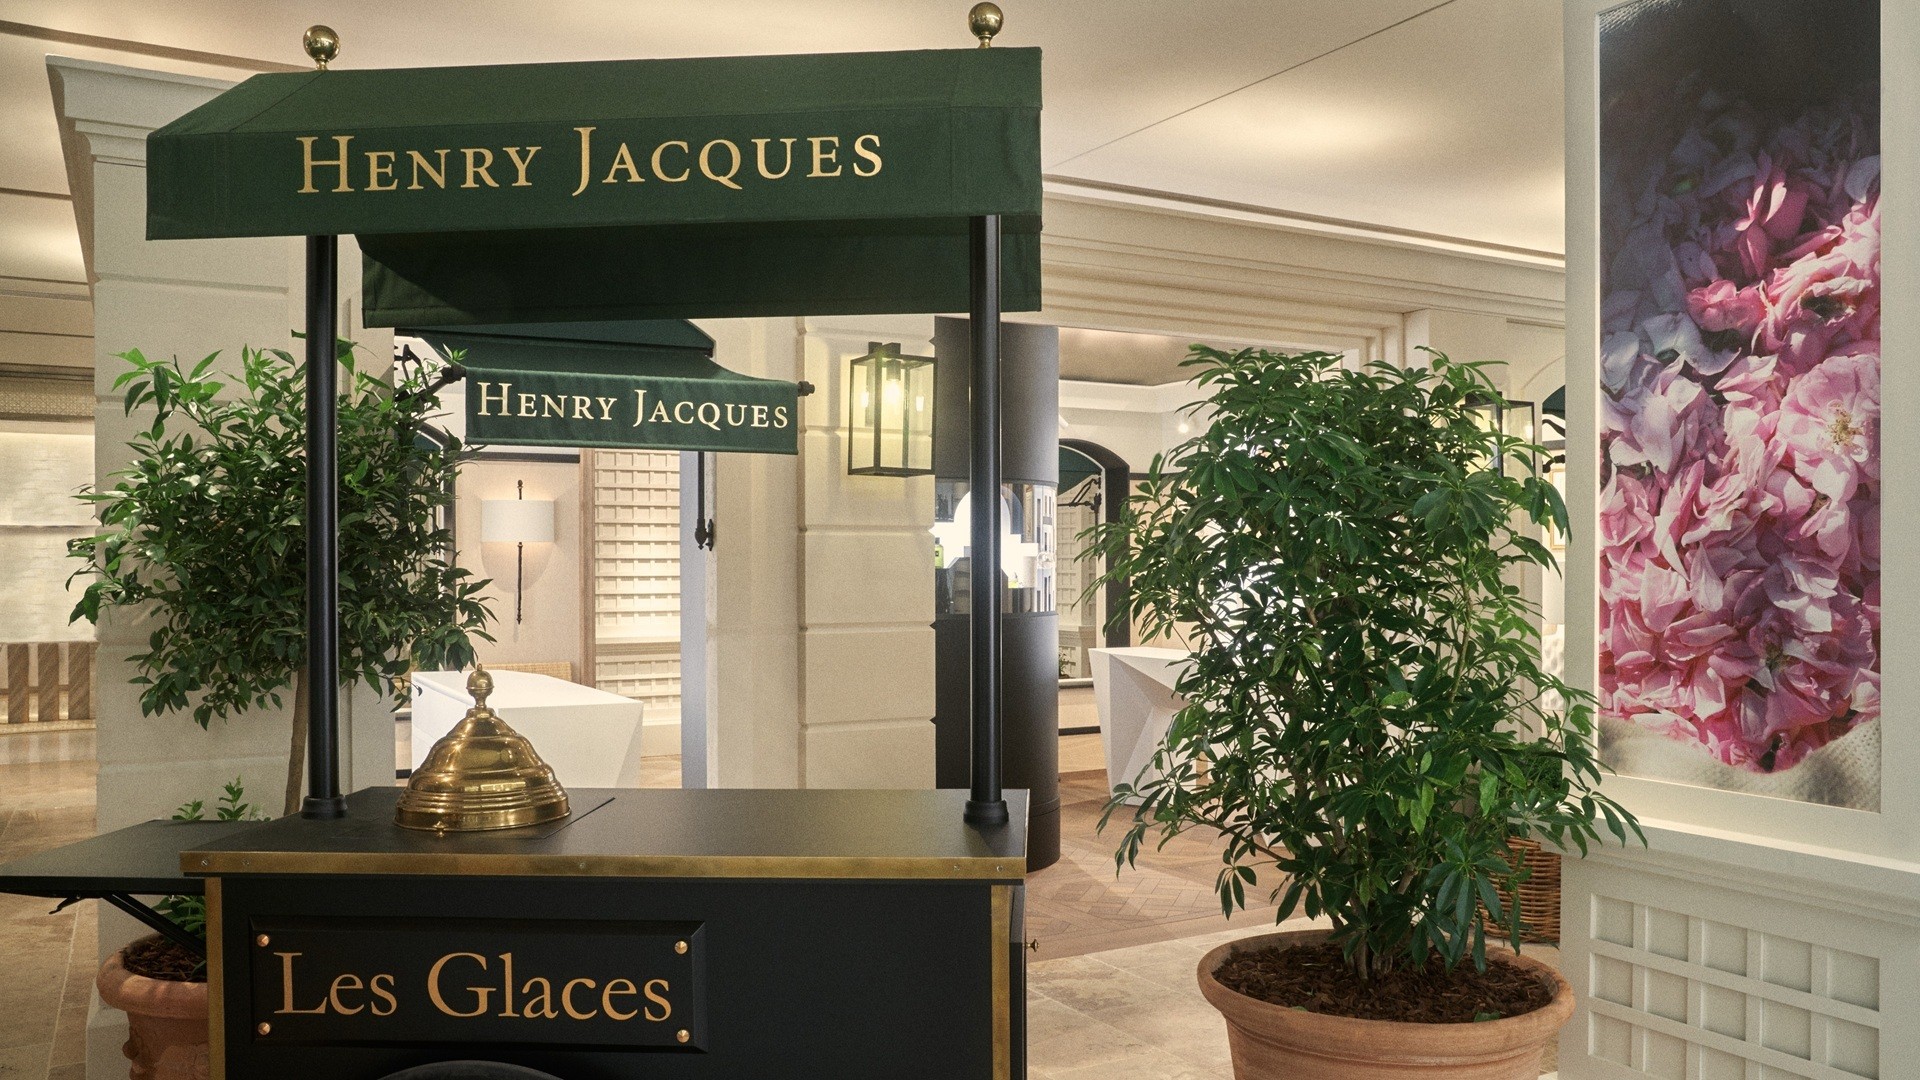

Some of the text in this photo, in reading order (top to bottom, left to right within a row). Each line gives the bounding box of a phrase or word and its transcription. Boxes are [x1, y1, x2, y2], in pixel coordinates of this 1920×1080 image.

[296, 127, 883, 196] HENRY JACQUES
[477, 381, 789, 431] HENRY JACQUES
[273, 952, 672, 1022] Les Glaces
